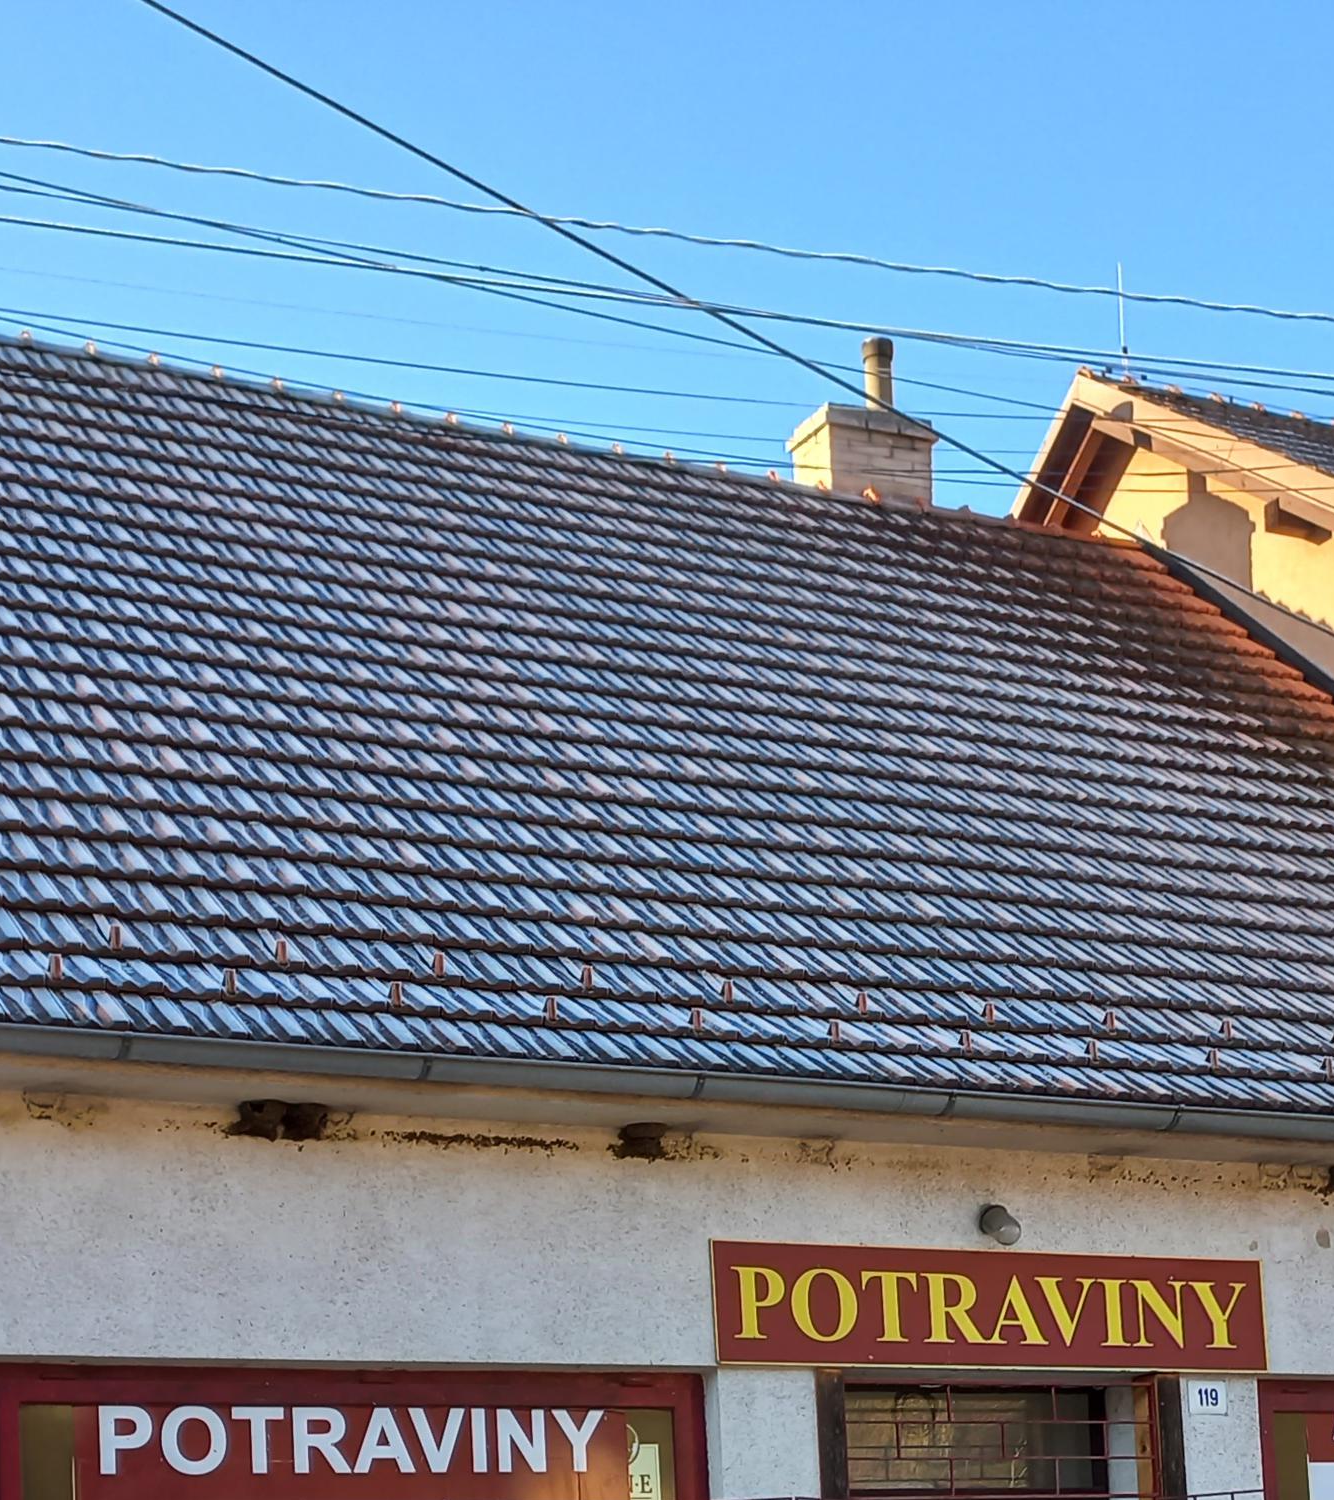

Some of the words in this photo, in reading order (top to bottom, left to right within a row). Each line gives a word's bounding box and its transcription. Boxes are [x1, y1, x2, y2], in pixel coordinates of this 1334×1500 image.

[730, 1265, 1246, 1350] POTRAVINY
[1197, 1387, 1219, 1407] 119
[97, 1405, 605, 1476] POTRAVINY
